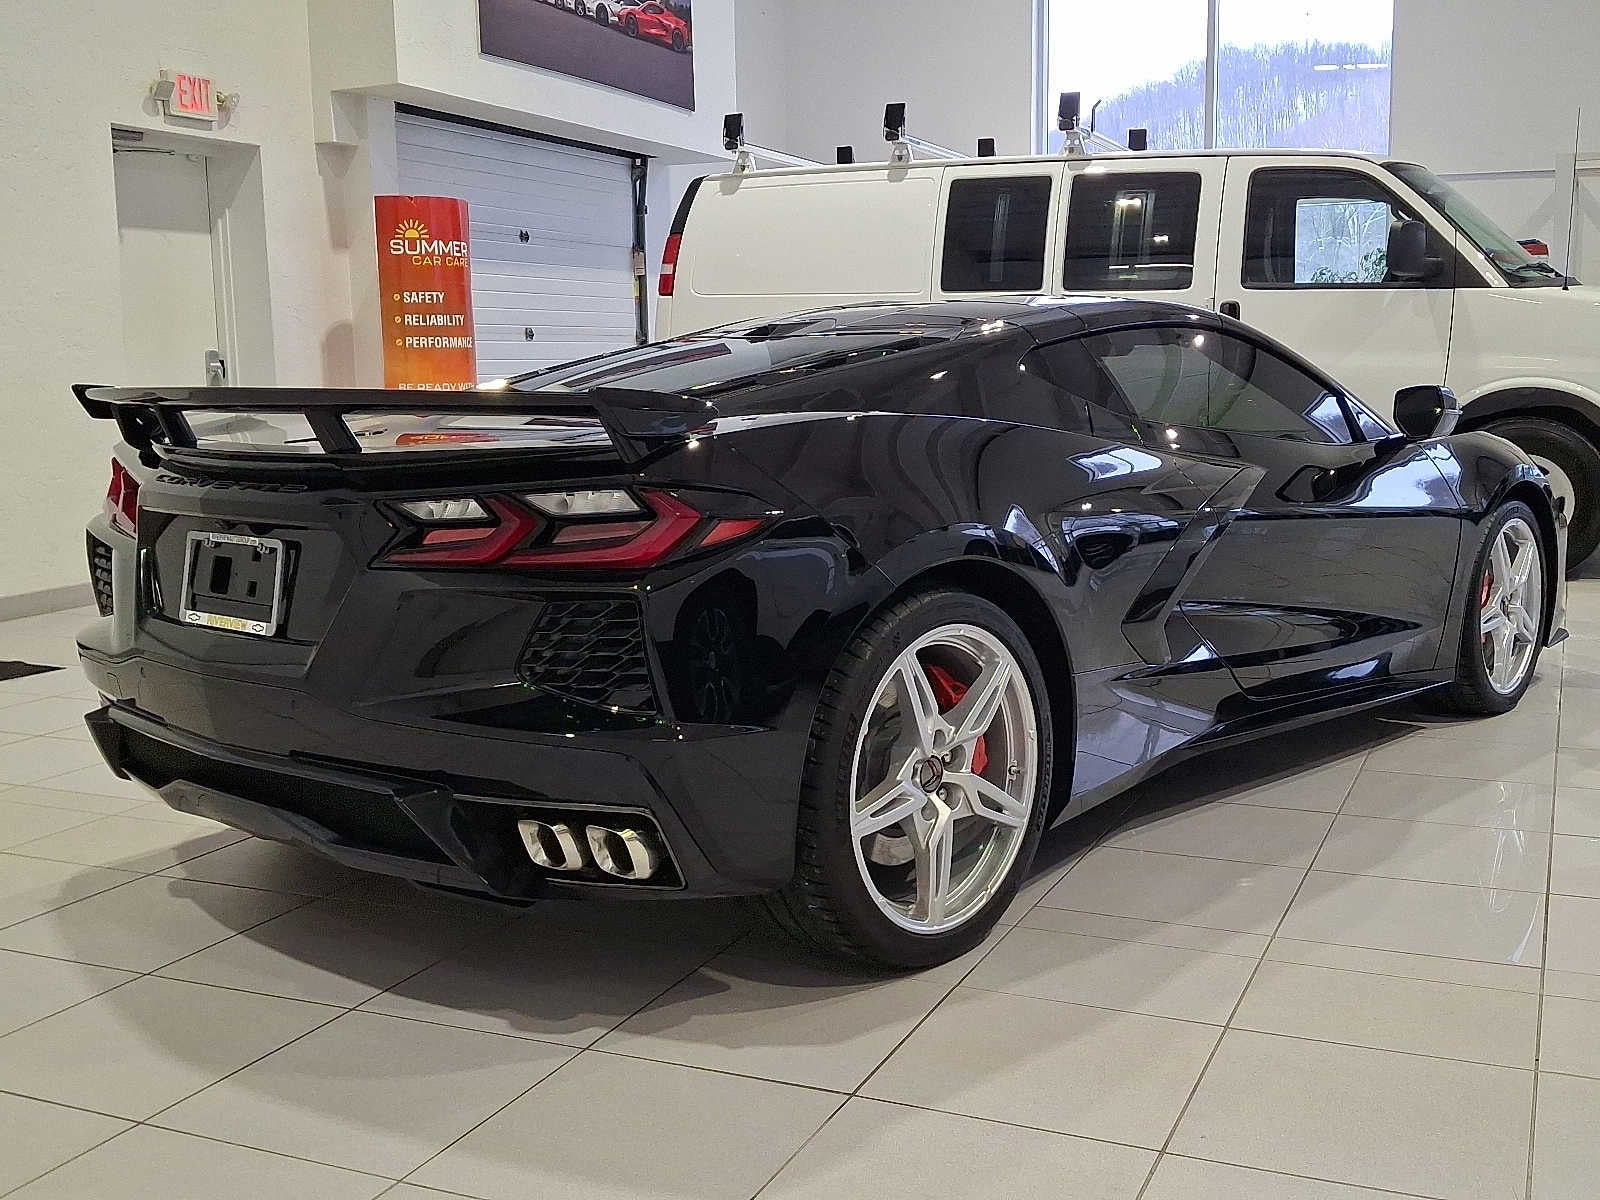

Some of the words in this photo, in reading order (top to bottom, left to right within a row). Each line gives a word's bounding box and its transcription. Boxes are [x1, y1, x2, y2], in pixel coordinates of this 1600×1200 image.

[176, 74, 211, 112] EXIT
[389, 239, 469, 257] SUMMER
[412, 255, 442, 267] CAR
[445, 256, 469, 268] CARE
[403, 291, 446, 304] SAFETY
[404, 313, 465, 326] RELIABILITY
[405, 336, 473, 348] PERFORMANCE
